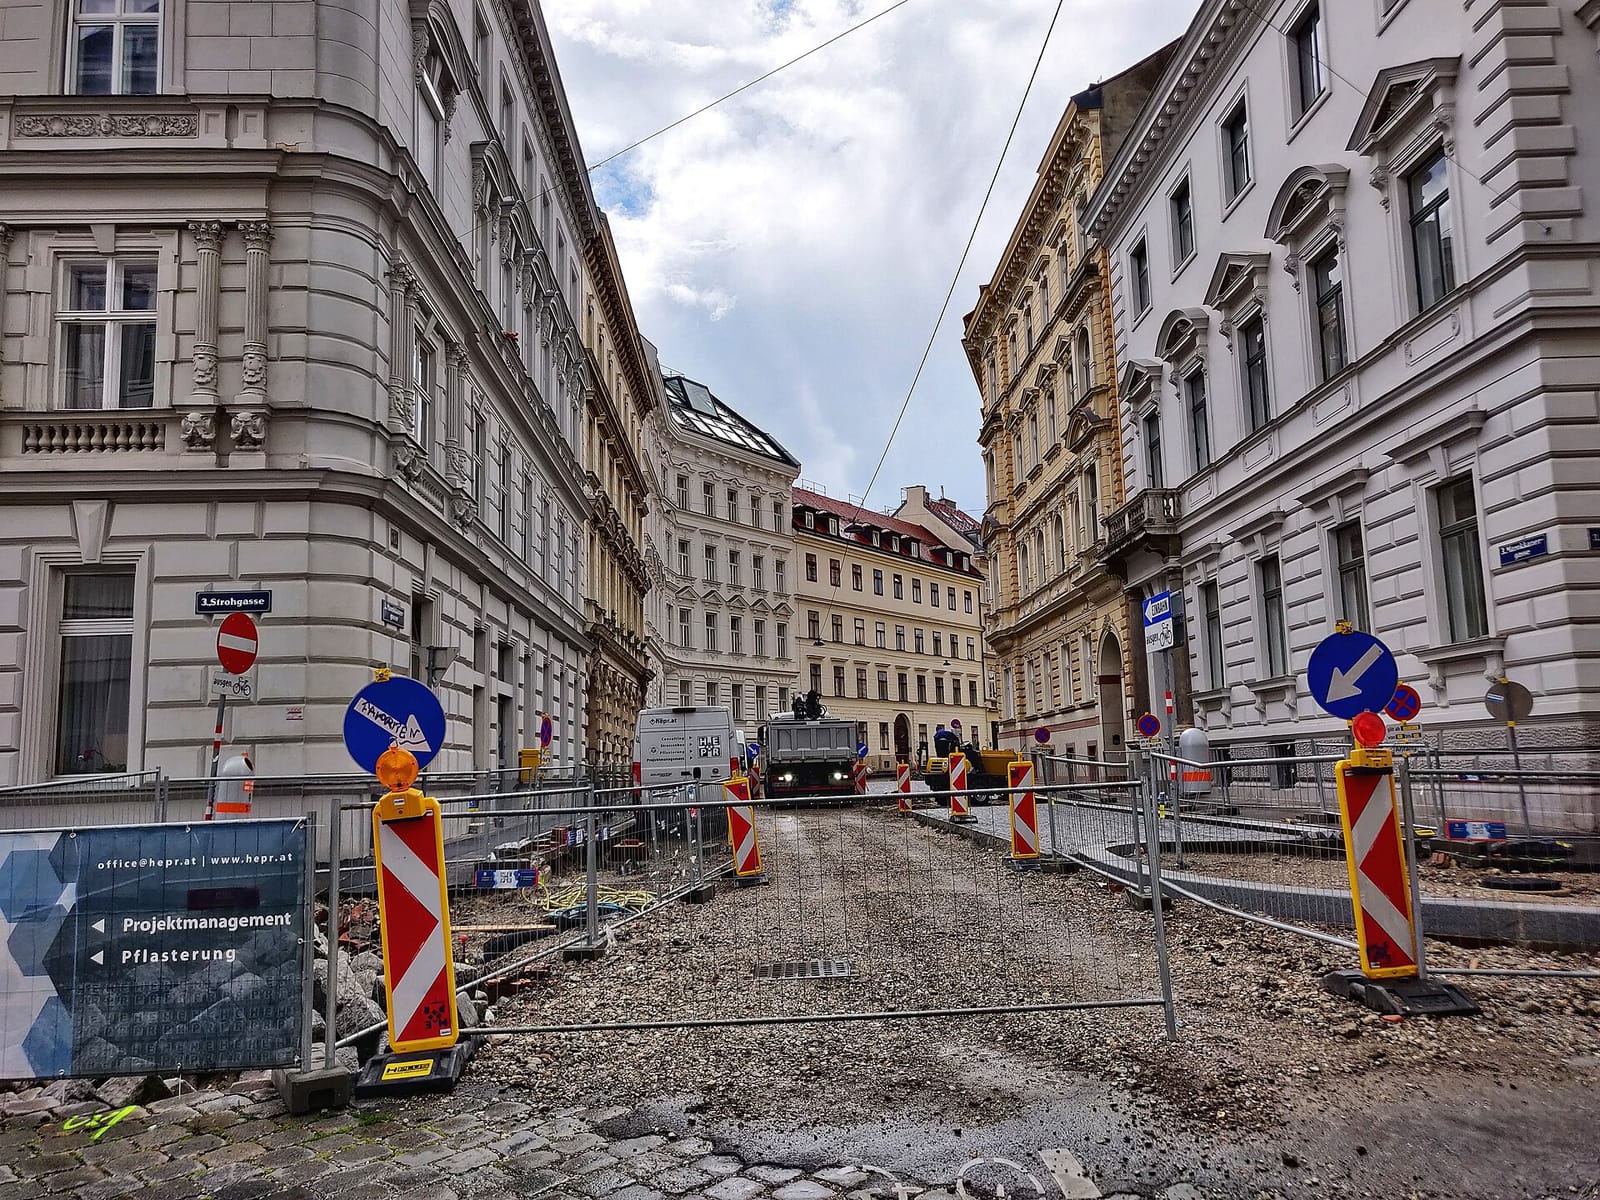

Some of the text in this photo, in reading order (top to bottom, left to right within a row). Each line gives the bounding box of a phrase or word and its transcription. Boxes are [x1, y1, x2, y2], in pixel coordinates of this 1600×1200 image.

[97, 853, 294, 870] office@hepr.at www.hepr.at
[123, 912, 291, 934] Projektmanagement
[121, 948, 237, 965] Pflasterung
